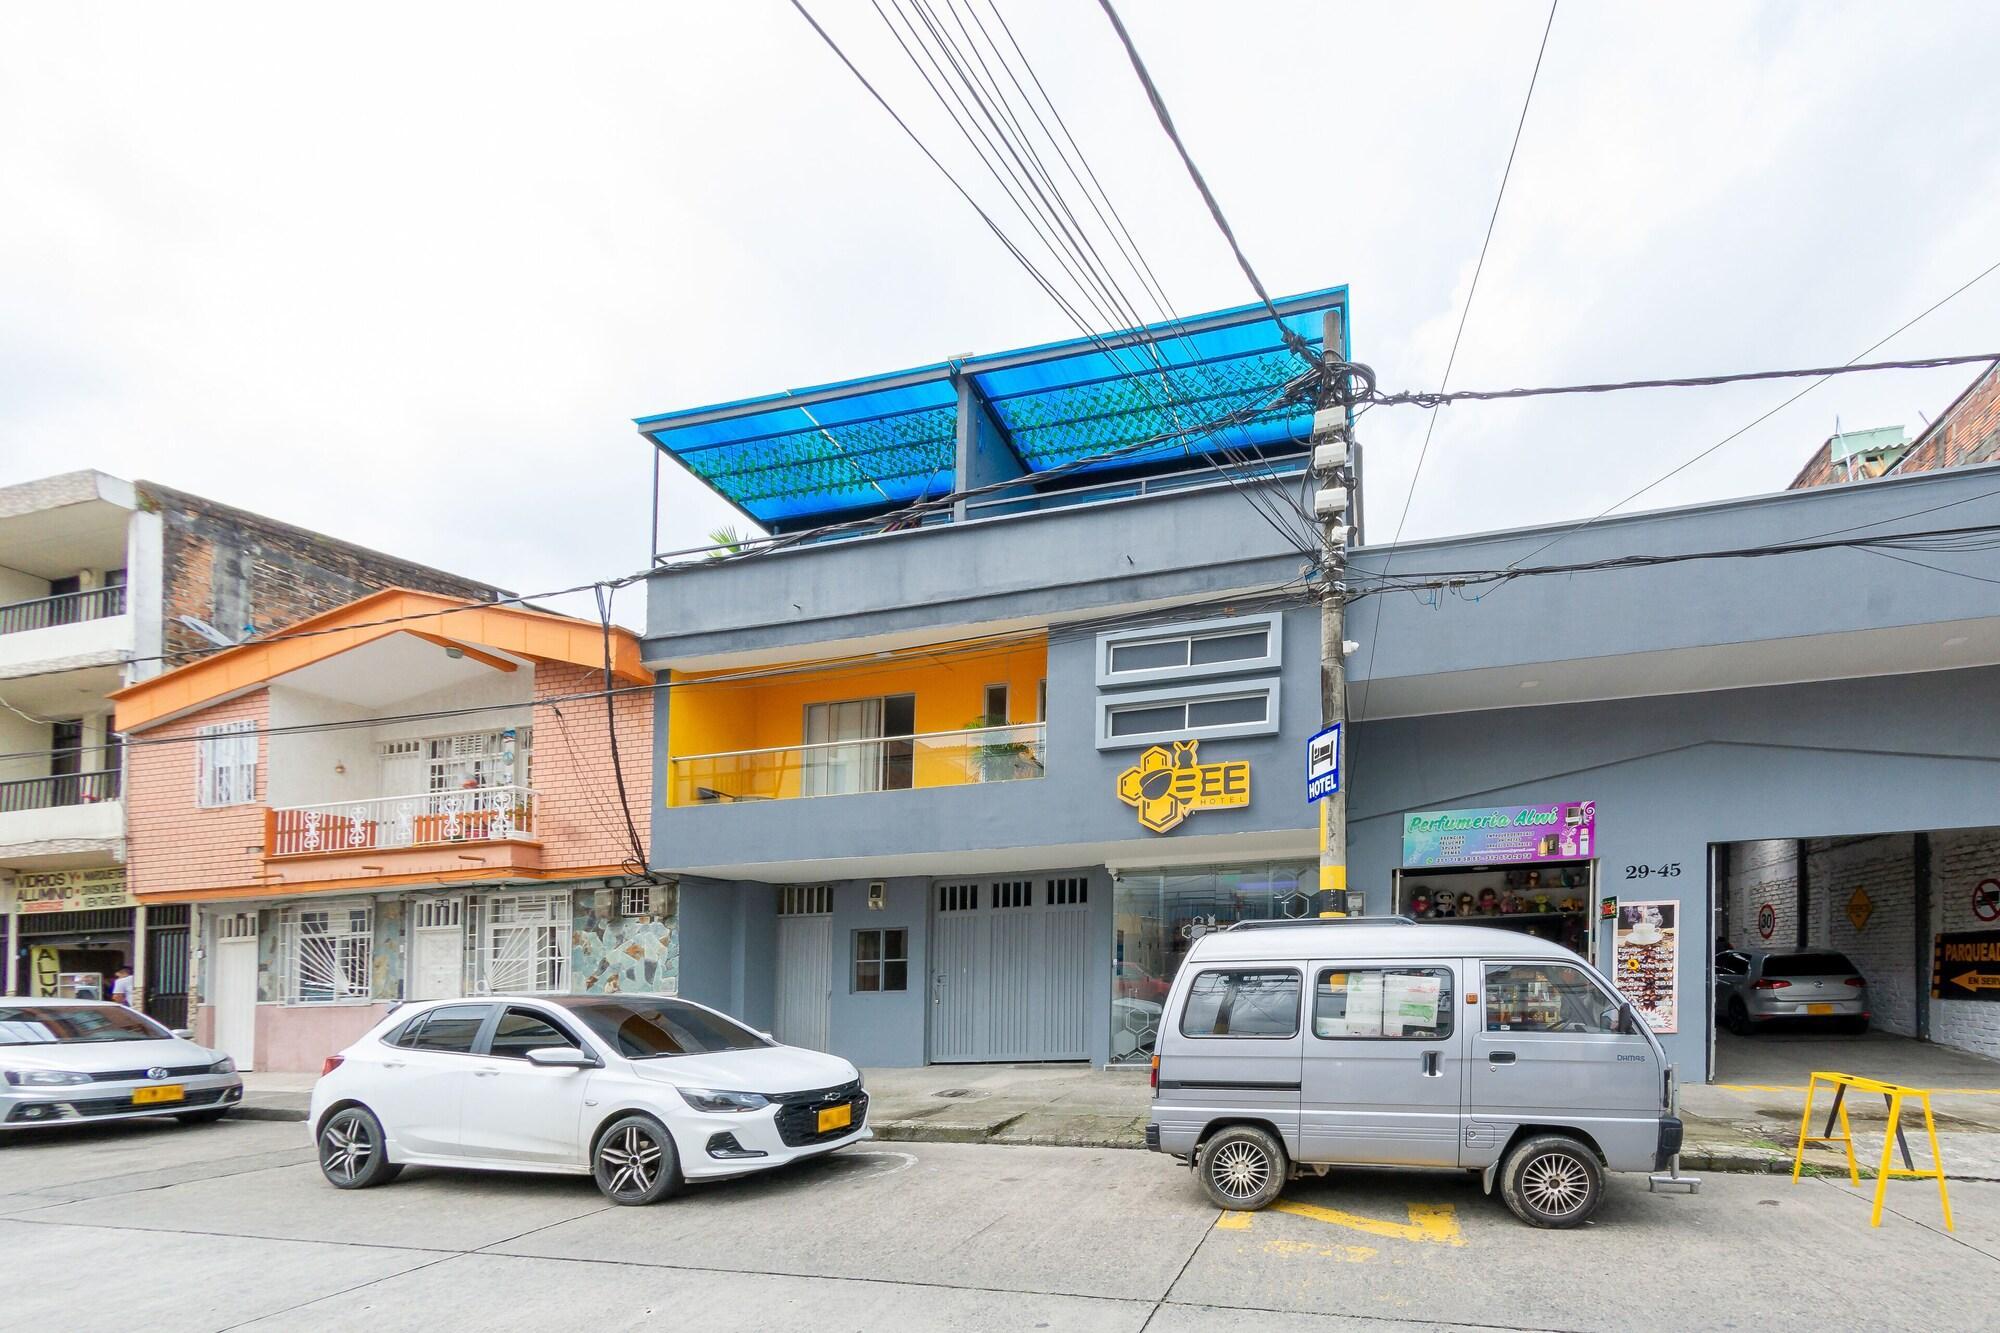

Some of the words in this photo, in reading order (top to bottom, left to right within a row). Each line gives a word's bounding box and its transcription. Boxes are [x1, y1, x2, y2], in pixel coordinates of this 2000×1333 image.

[1309, 774, 1337, 799] HOTEL
[1200, 796, 1245, 805] HOTEL
[1626, 863, 1681, 879] 29-45
[17, 872, 66, 889] VIDRIOS
[16, 886, 73, 902] ALUMINIO
[1761, 913, 1772, 928] 30
